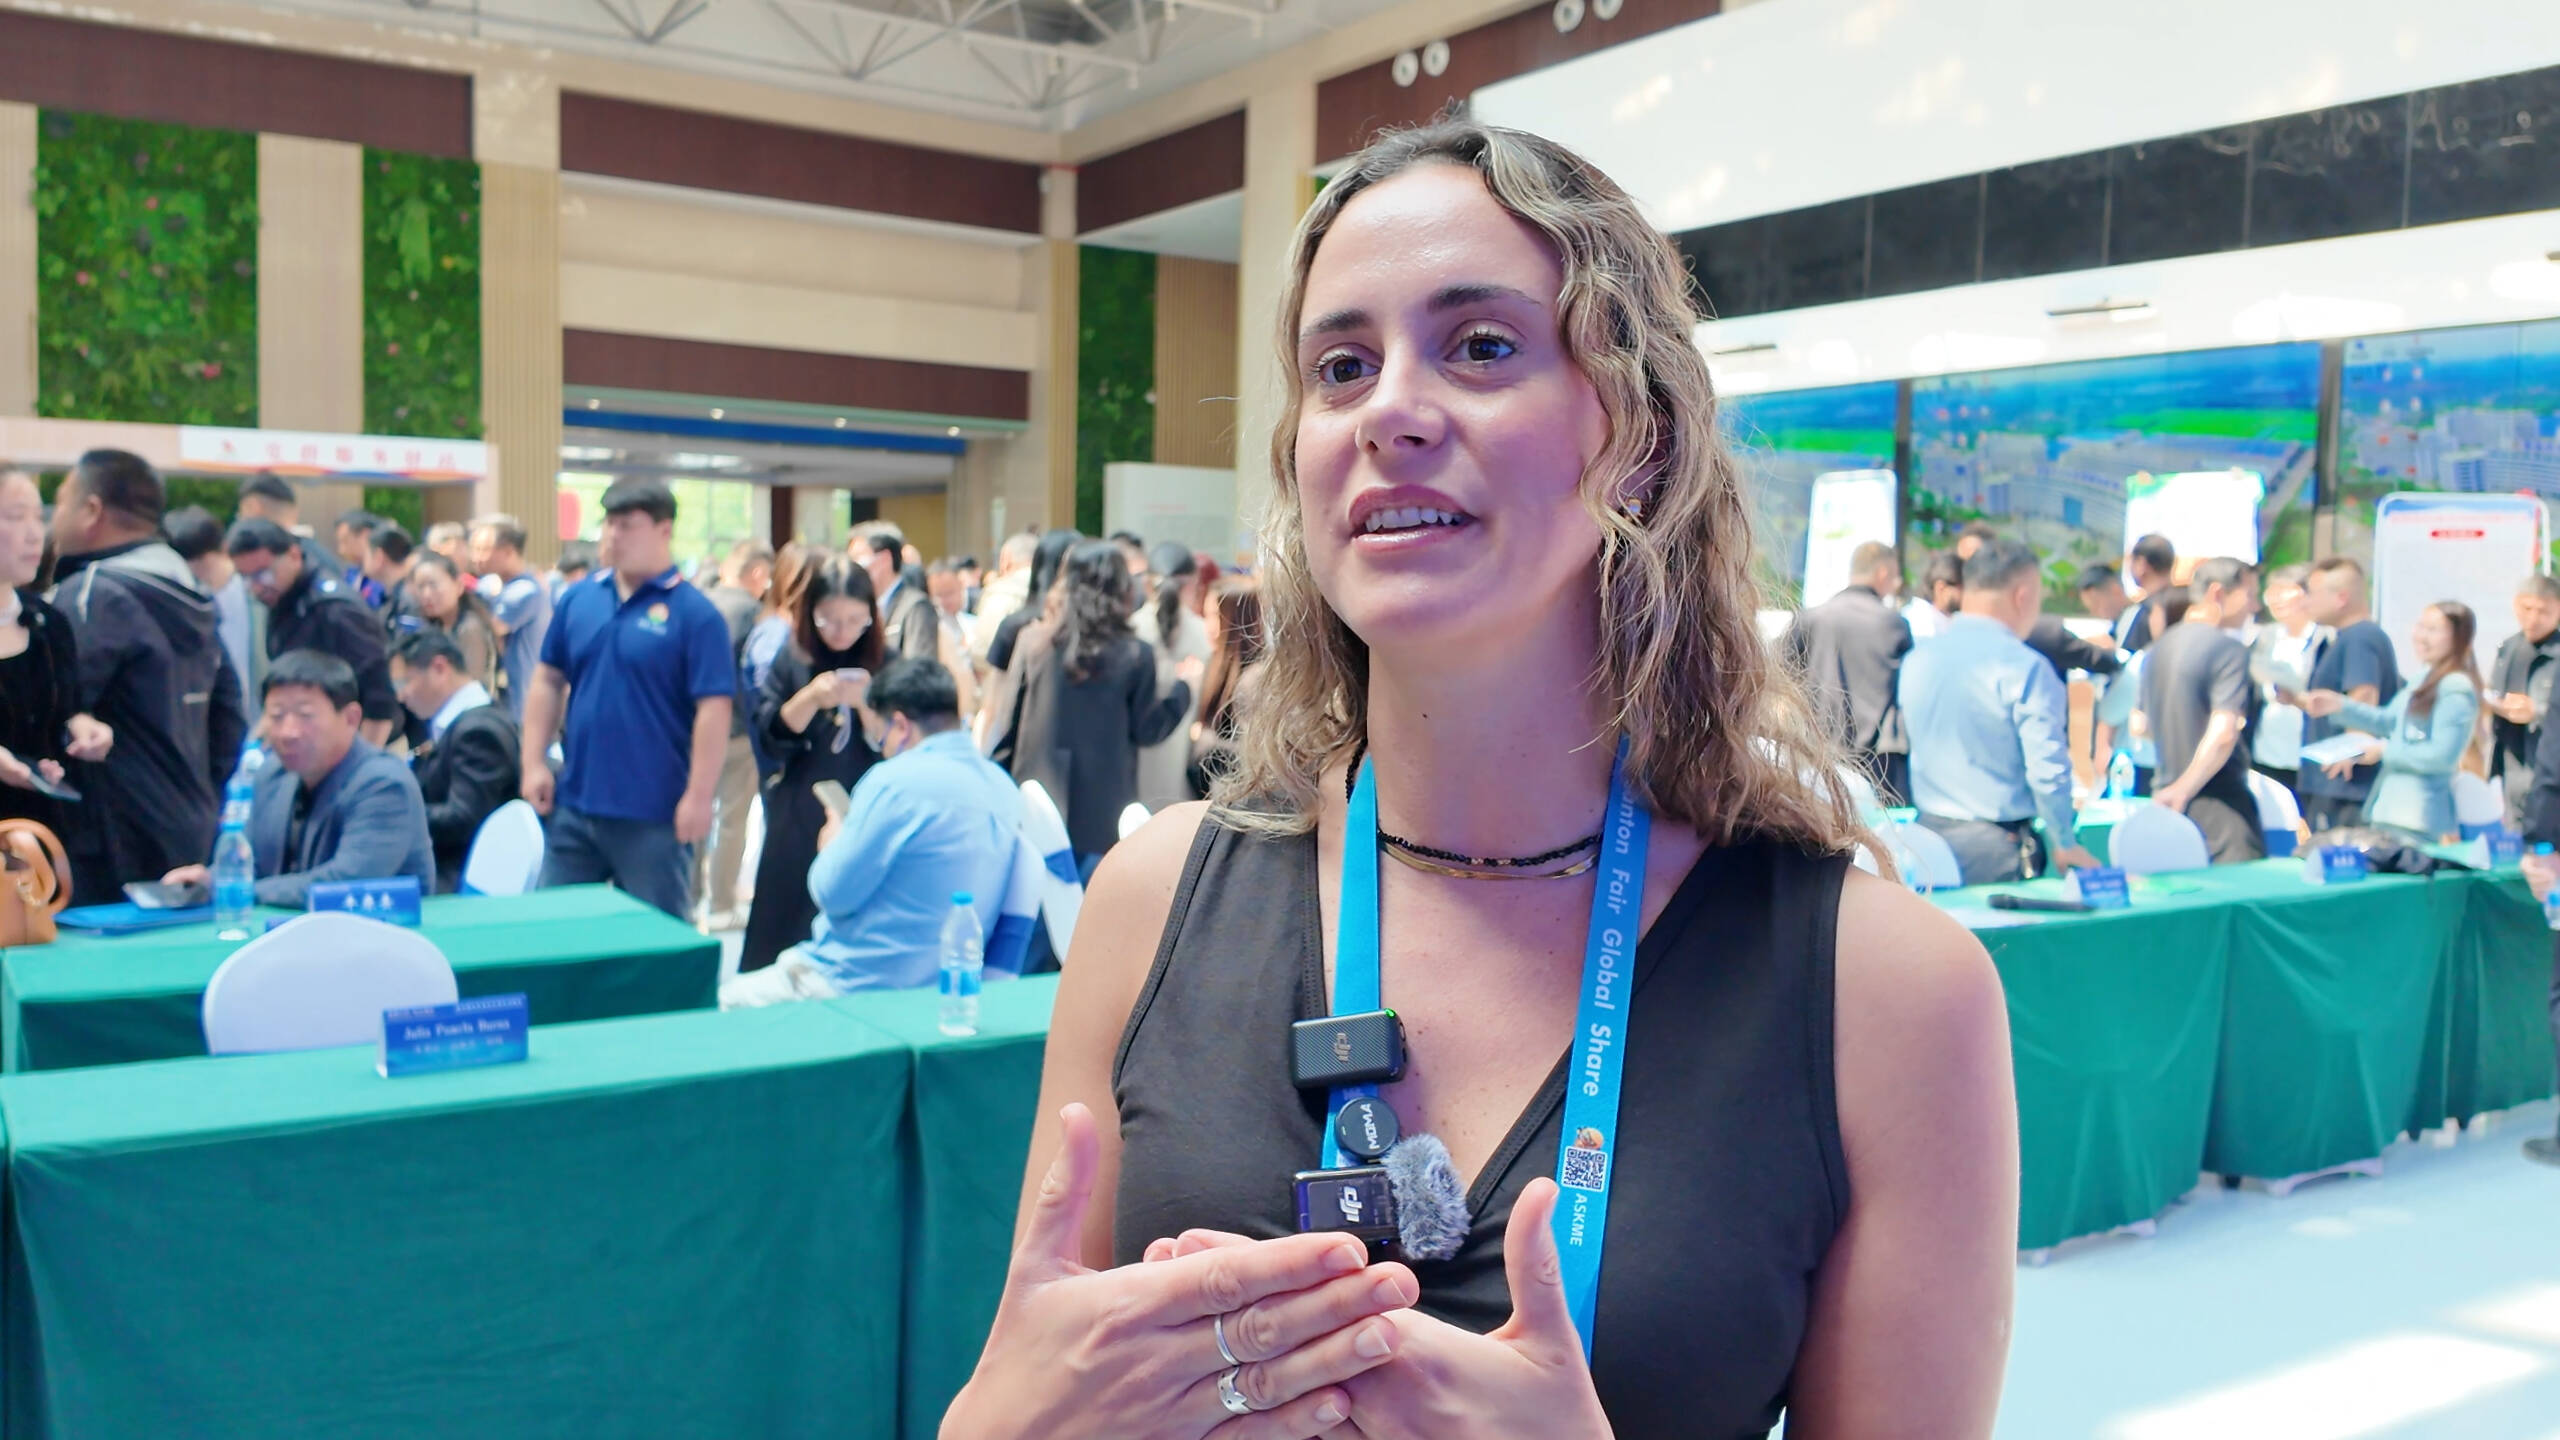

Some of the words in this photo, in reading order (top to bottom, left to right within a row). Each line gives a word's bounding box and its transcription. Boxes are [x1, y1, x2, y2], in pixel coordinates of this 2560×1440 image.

[1607, 867, 1631, 915] Fair
[1594, 928, 1623, 1010] Global
[1582, 1022, 1612, 1097] Share
[1569, 1193, 1588, 1247] ASKME
